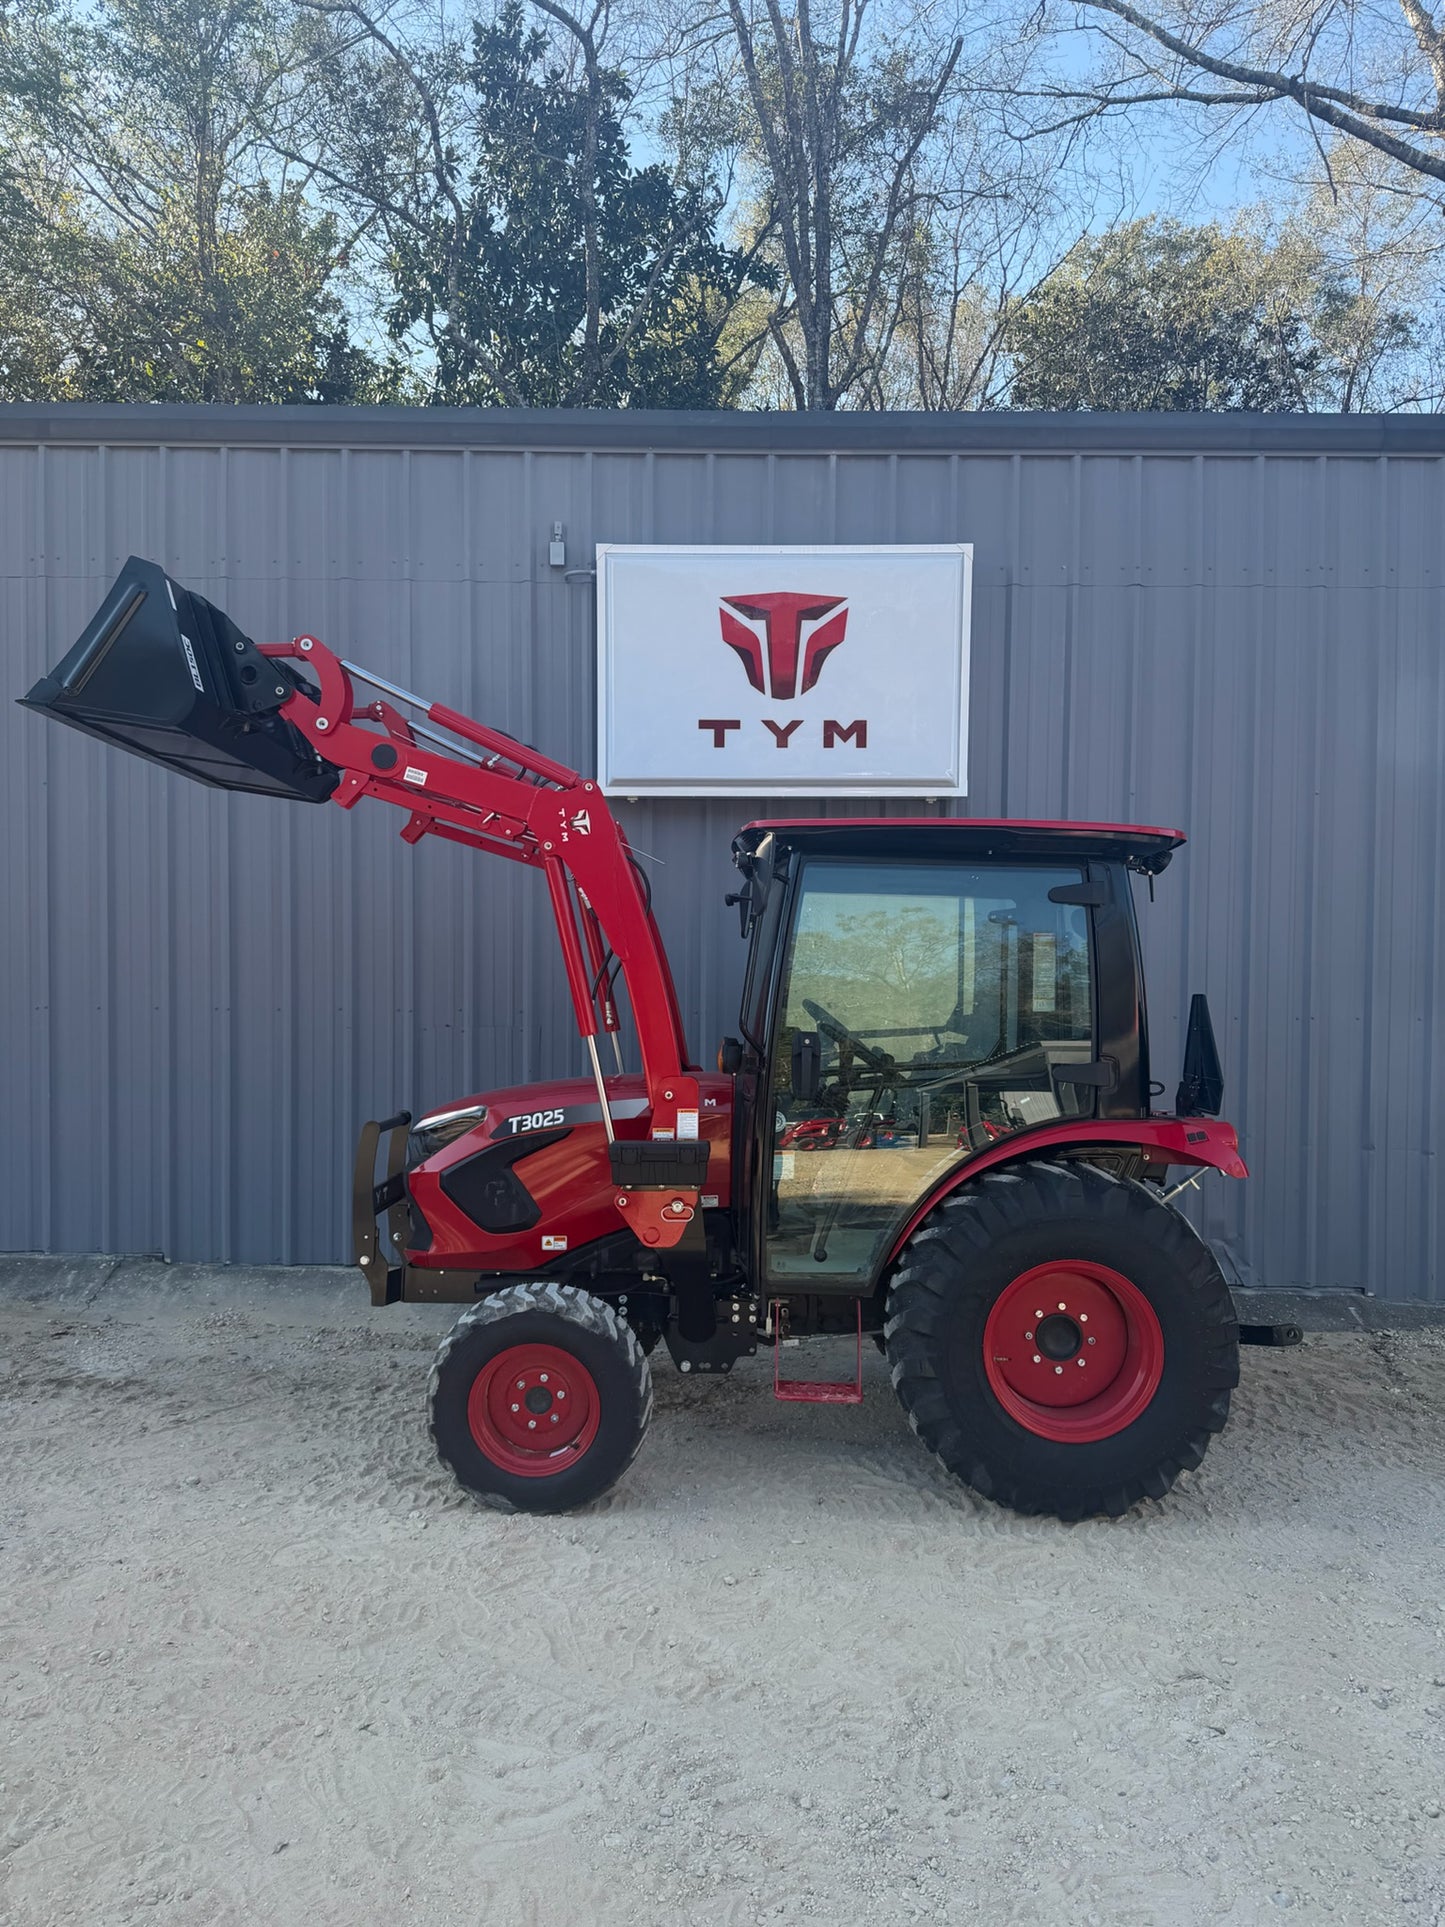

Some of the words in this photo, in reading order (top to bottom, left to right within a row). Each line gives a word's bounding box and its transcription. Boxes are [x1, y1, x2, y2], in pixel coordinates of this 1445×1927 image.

[698, 719, 868, 749] TYM
[558, 807, 569, 842] TYM
[508, 1108, 565, 1134] T3025
